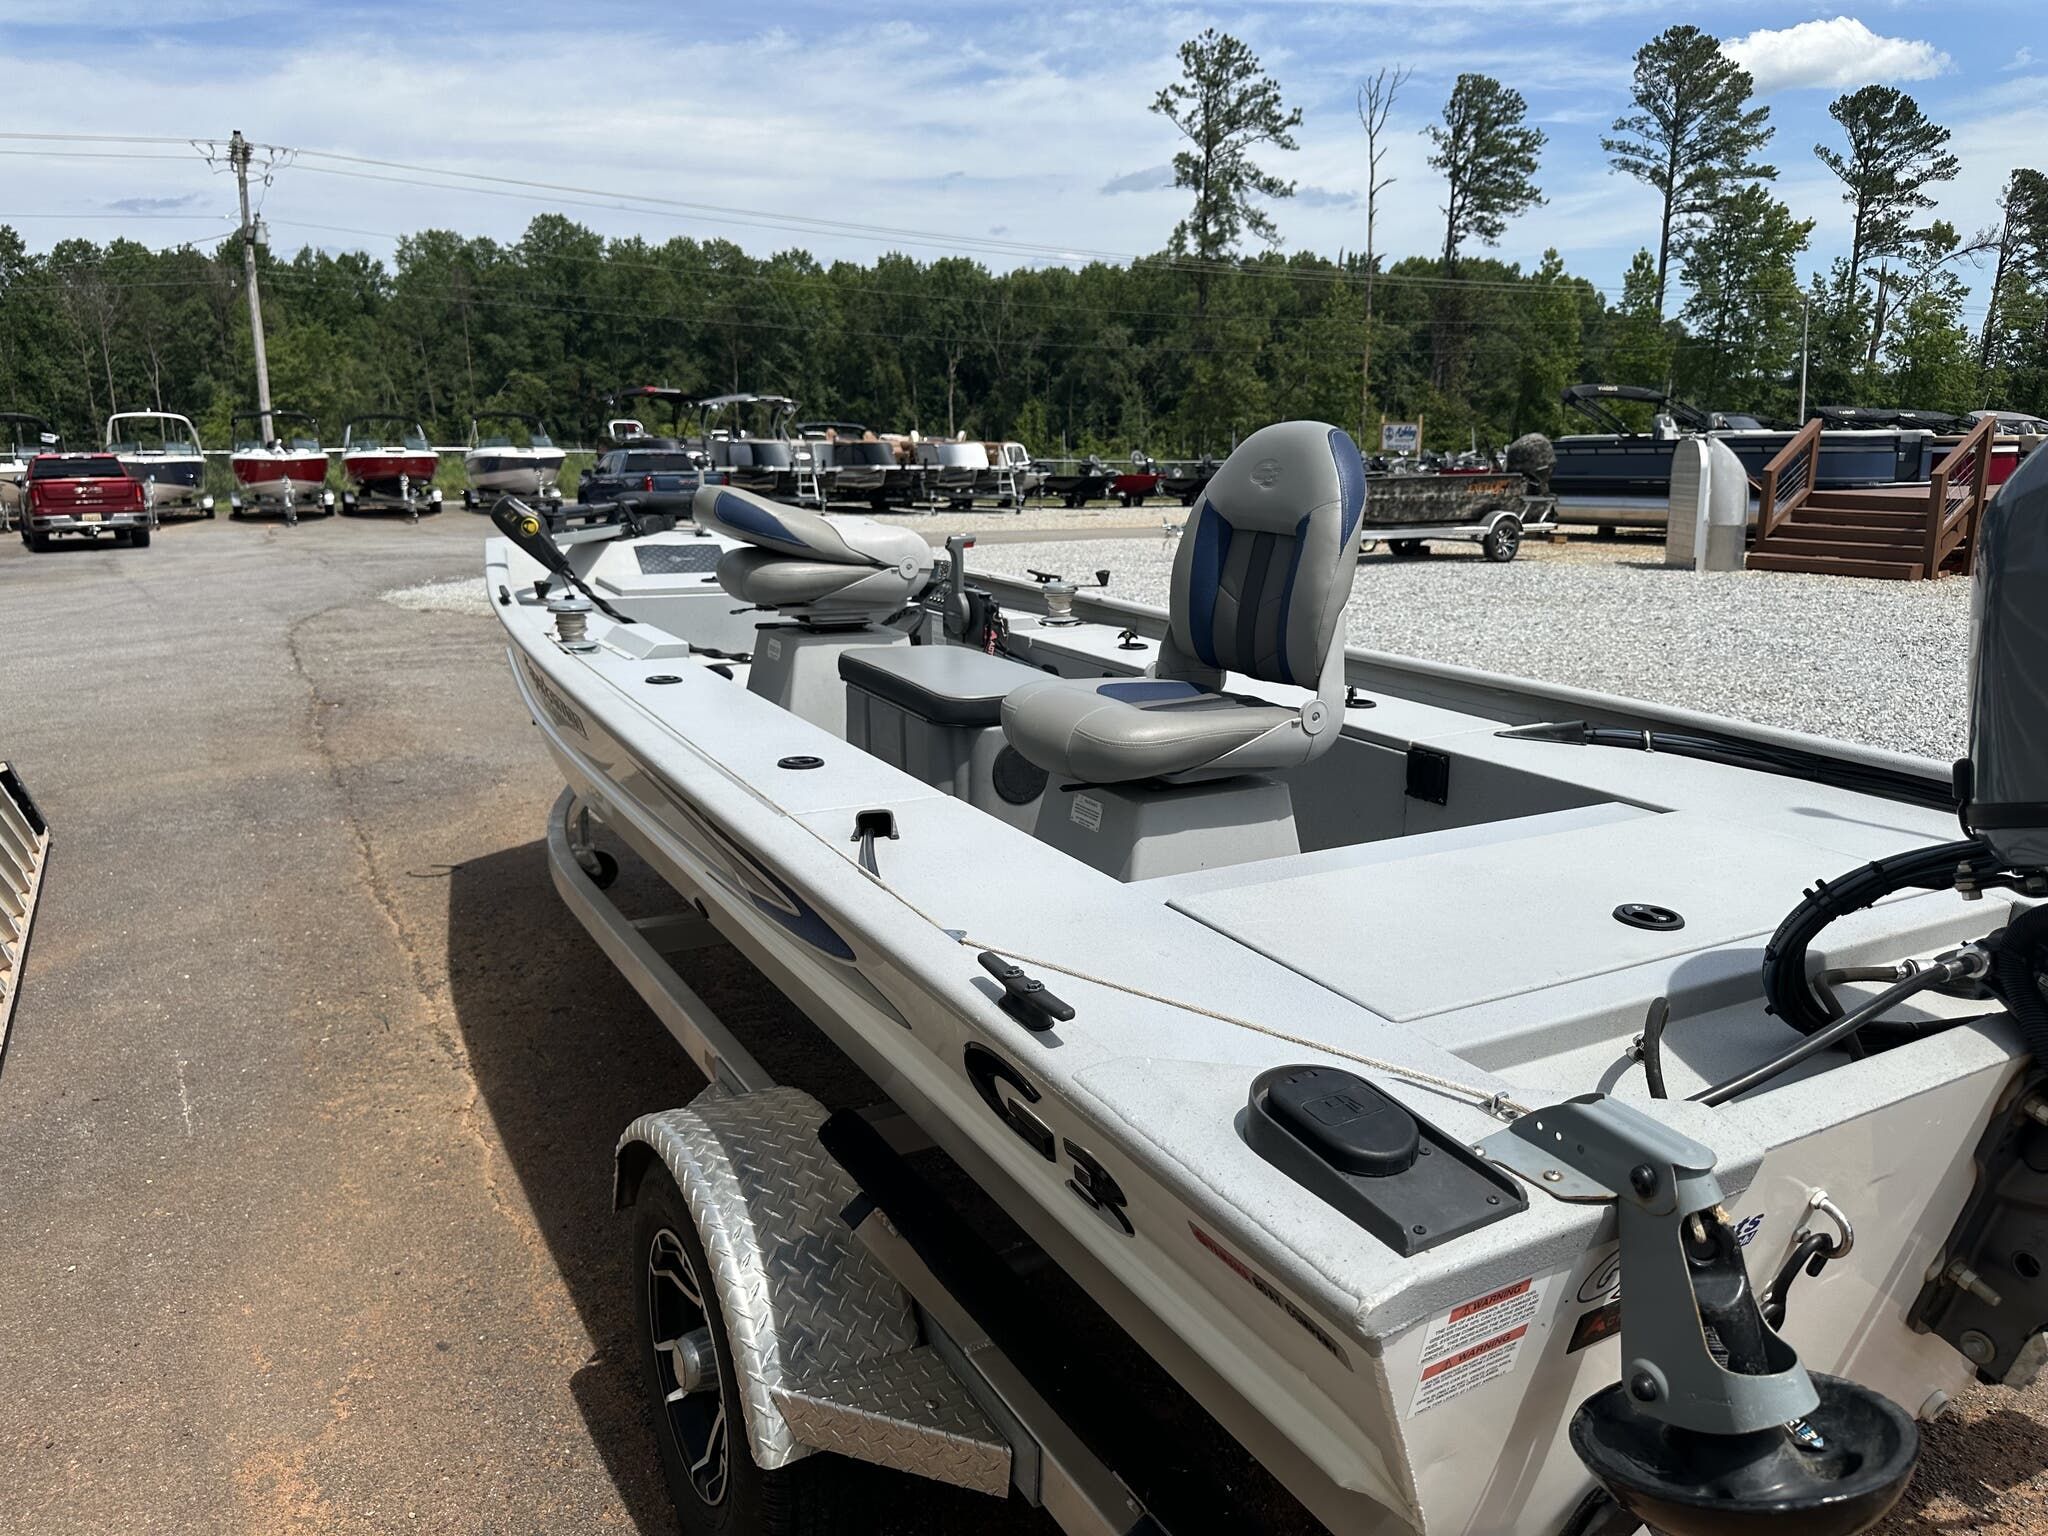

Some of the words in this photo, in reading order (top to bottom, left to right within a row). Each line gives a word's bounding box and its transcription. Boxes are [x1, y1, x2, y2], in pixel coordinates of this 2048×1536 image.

[964, 1041, 1135, 1237] G3
[1473, 1284, 1522, 1311] WARNING
[1458, 1333, 1511, 1360] WARNING
